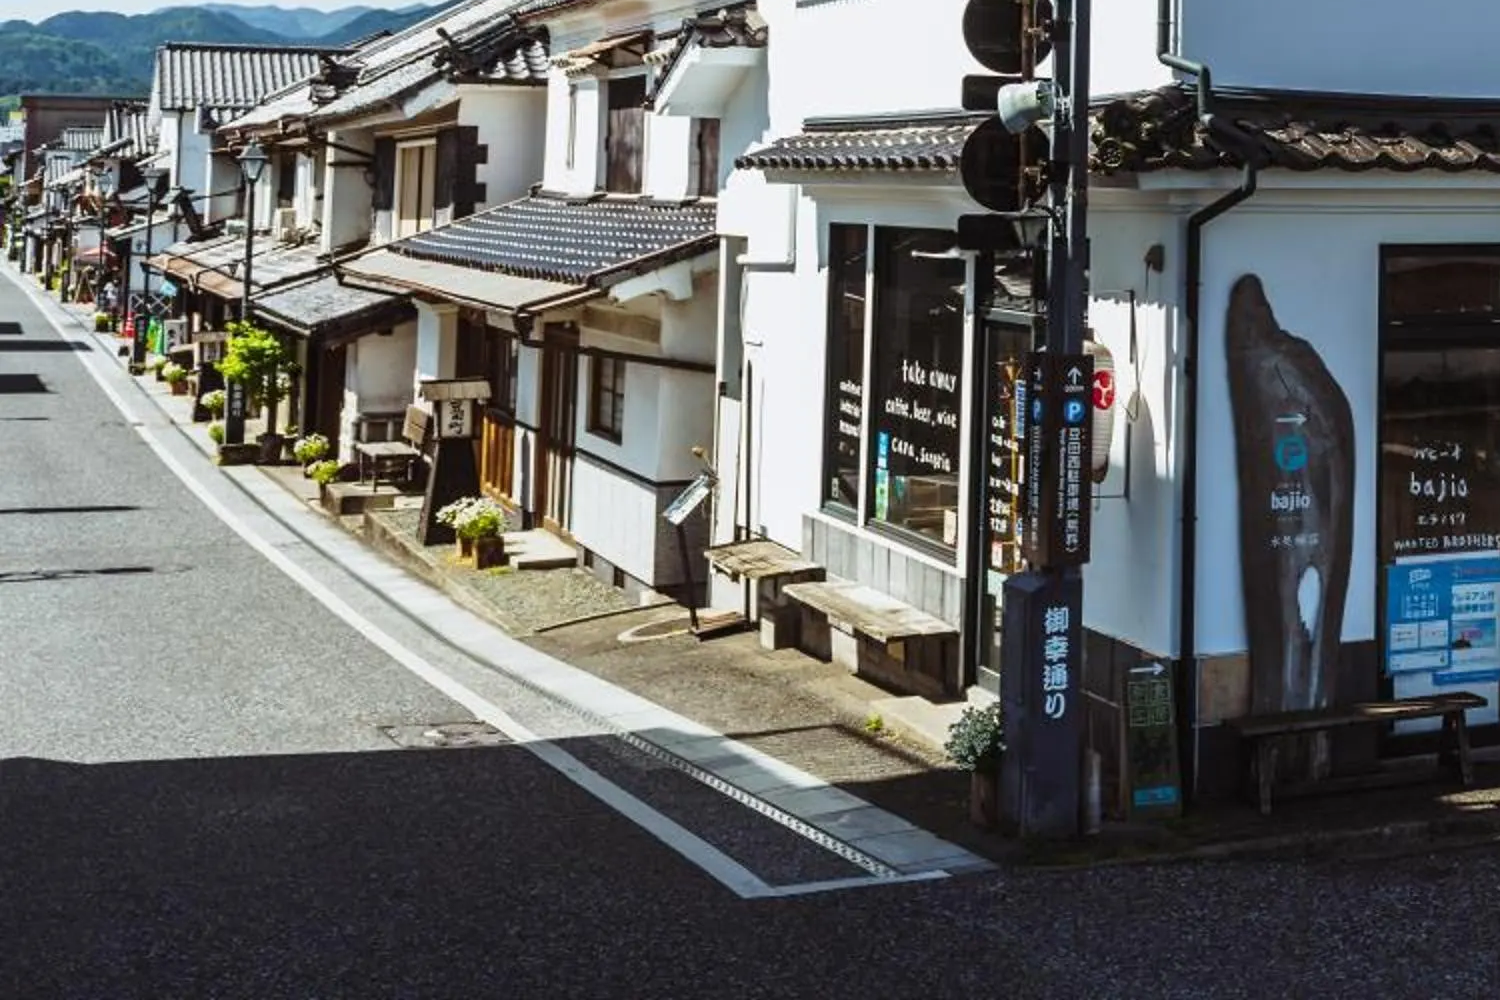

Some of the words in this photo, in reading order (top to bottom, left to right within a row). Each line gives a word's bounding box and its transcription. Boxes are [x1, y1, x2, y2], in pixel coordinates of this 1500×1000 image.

[1069, 401, 1081, 420] P
[1409, 471, 1468, 502] bajio
[1271, 490, 1311, 512] bajio
[1043, 607, 1069, 719] 御幸通り
